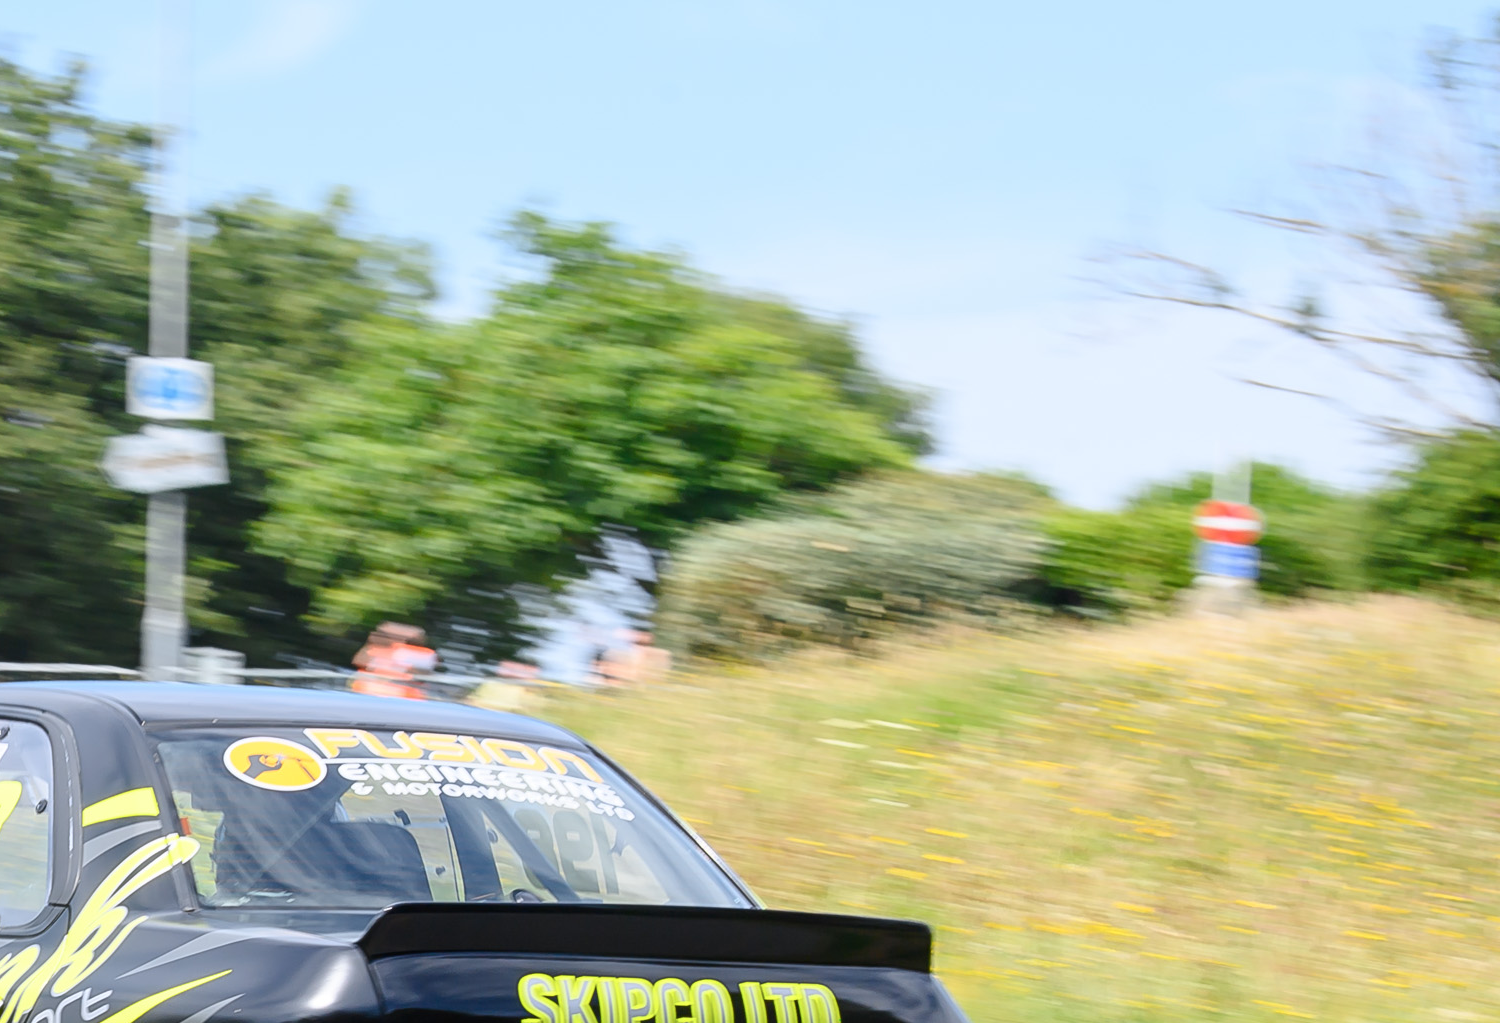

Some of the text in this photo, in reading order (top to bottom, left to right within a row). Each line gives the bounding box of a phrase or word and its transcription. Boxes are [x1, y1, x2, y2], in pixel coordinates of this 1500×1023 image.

[303, 727, 604, 784] FUSION
[338, 763, 626, 807] ENGINEERING
[585, 801, 636, 822] LTD
